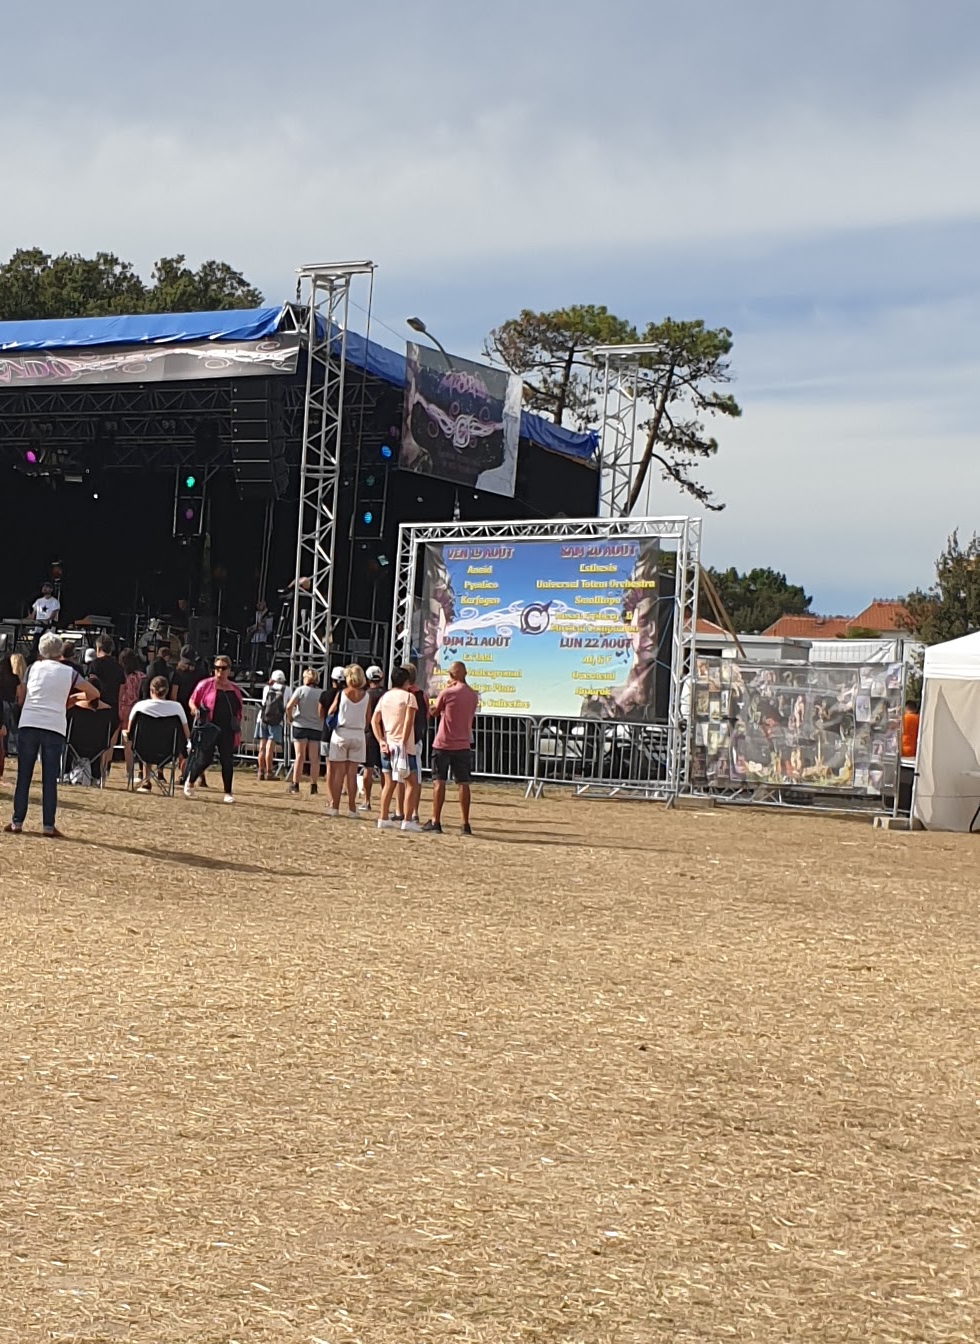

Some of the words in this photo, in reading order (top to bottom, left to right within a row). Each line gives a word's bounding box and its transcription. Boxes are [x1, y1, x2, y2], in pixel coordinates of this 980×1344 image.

[465, 637, 480, 647] 21
[560, 638, 583, 649] LUN
[584, 638, 600, 648] 22
